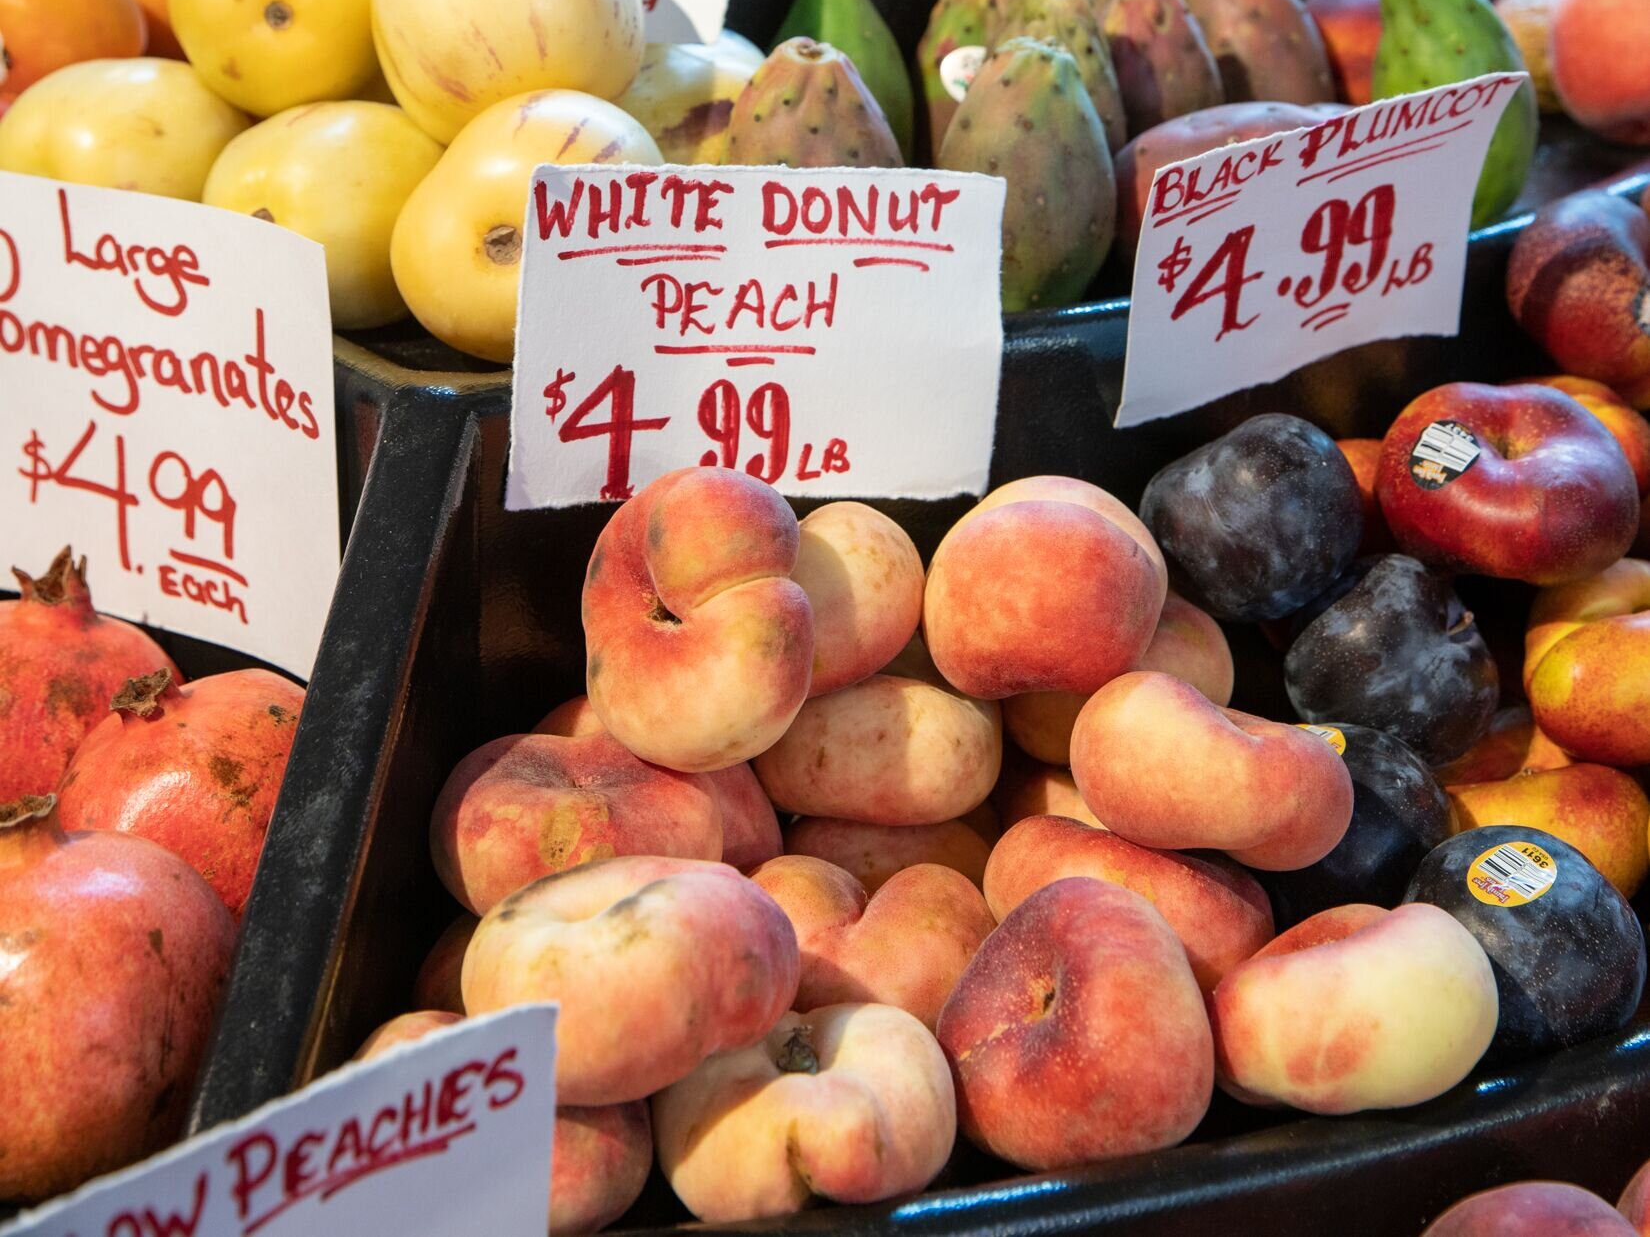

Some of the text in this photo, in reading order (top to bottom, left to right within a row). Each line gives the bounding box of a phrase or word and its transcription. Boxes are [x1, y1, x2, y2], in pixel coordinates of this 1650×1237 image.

[1151, 75, 1525, 219] BLACK PLUMCOT
[533, 171, 961, 241] WHITE DONUT
[57, 187, 210, 317] Large
[1381, 242, 1434, 296] LB
[640, 272, 839, 337] PEACH
[793, 437, 851, 481] LB
[1521, 847, 1549, 869] 3611
[226, 1046, 526, 1220] PEACHES
